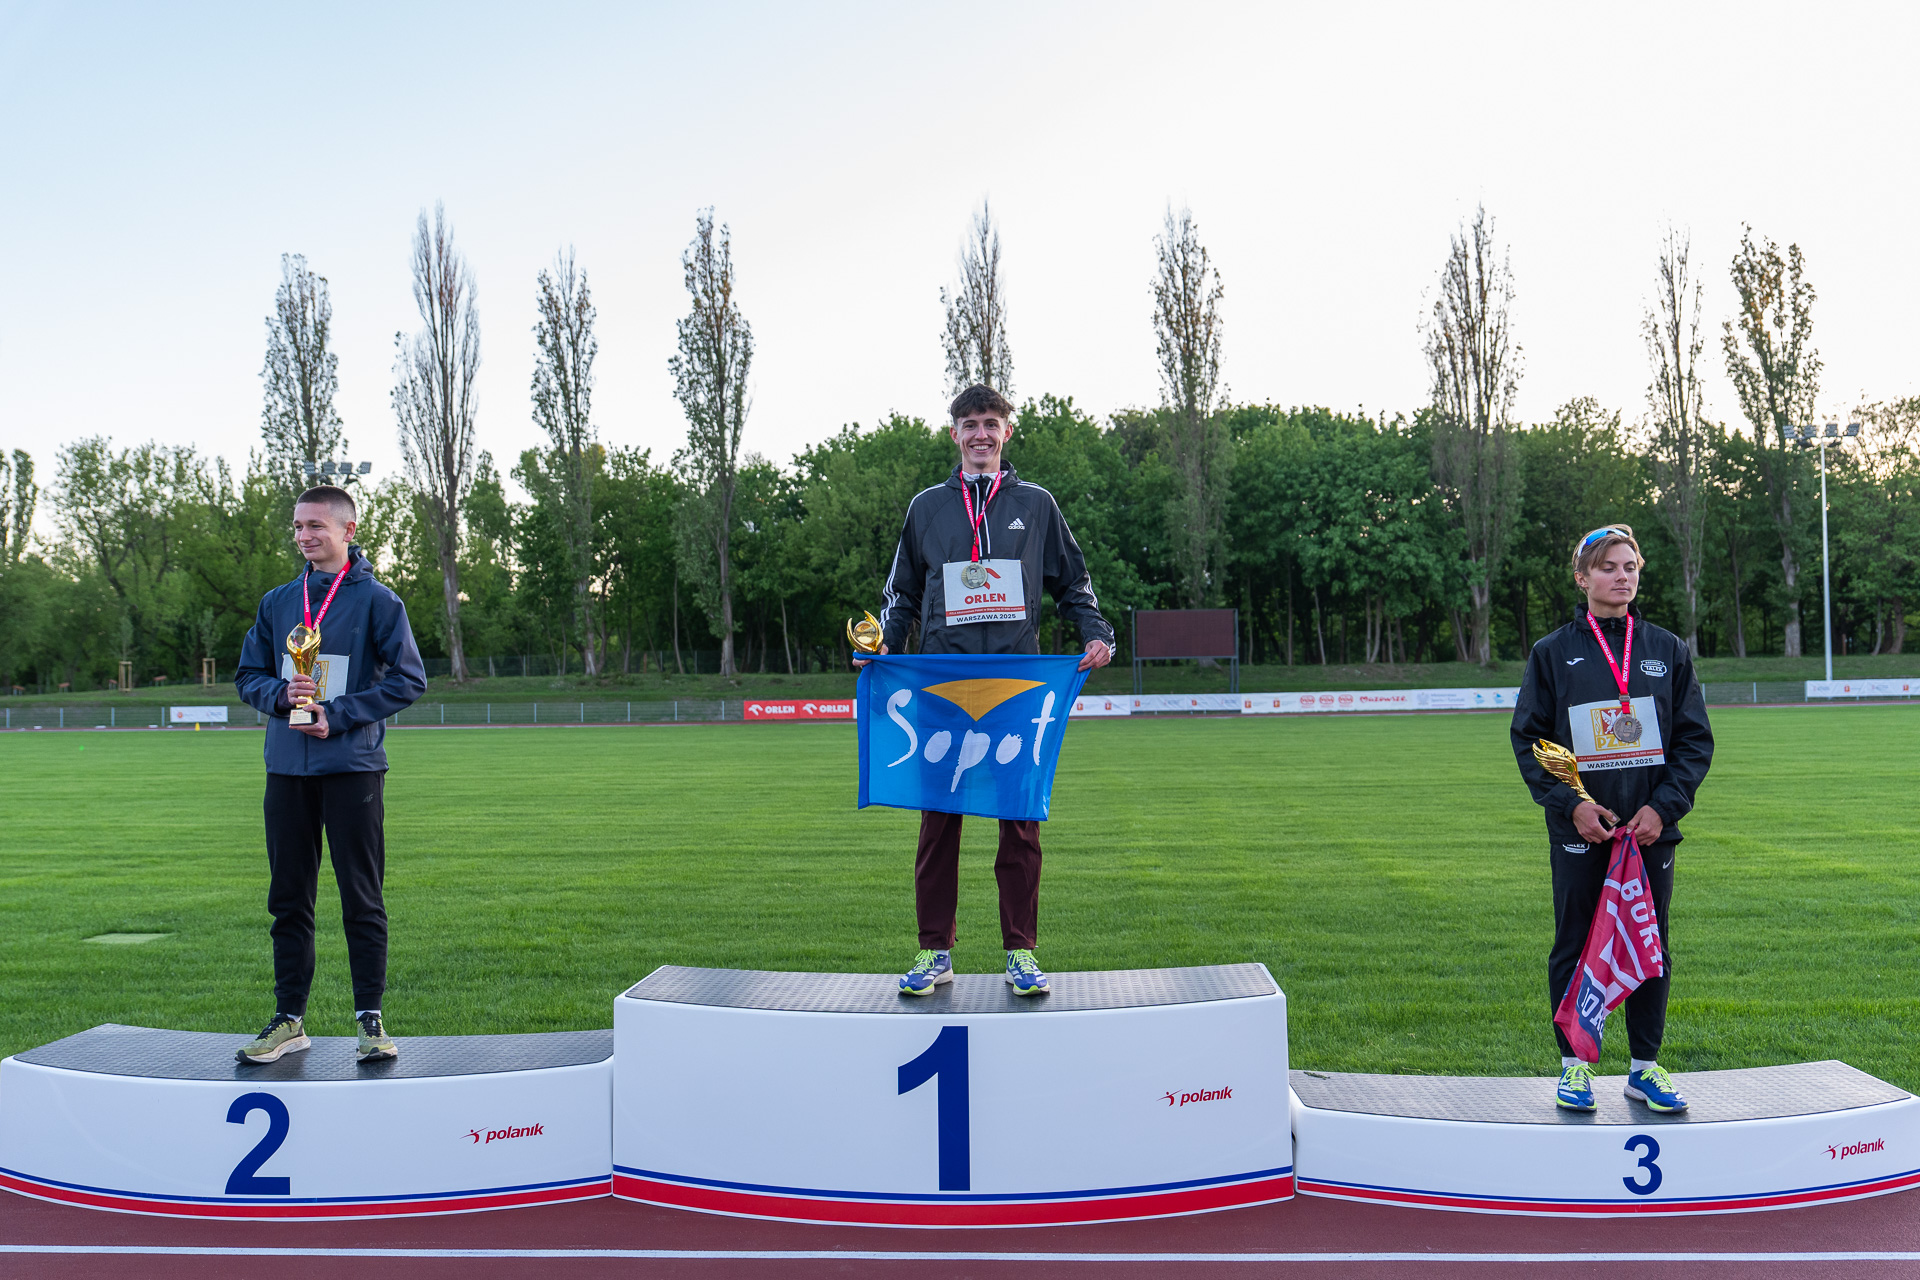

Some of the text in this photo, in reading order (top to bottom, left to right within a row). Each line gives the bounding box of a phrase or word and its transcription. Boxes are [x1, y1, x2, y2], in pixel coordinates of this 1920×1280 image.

[964, 593, 1007, 605] ORLEN
[956, 613, 998, 623] WARSZAWA
[765, 705, 795, 714] ORLEN
[819, 704, 850, 713] ORLEN
[887, 688, 1056, 793] Sopot
[1586, 757, 1653, 769] WARSZAWA 2025
[1179, 1086, 1233, 1107] polanik
[897, 1025, 971, 1192] 1
[224, 1092, 291, 1195] 2
[485, 1122, 545, 1144] polanik
[1840, 1137, 1885, 1160] polanik
[1622, 1134, 1663, 1195] 3
